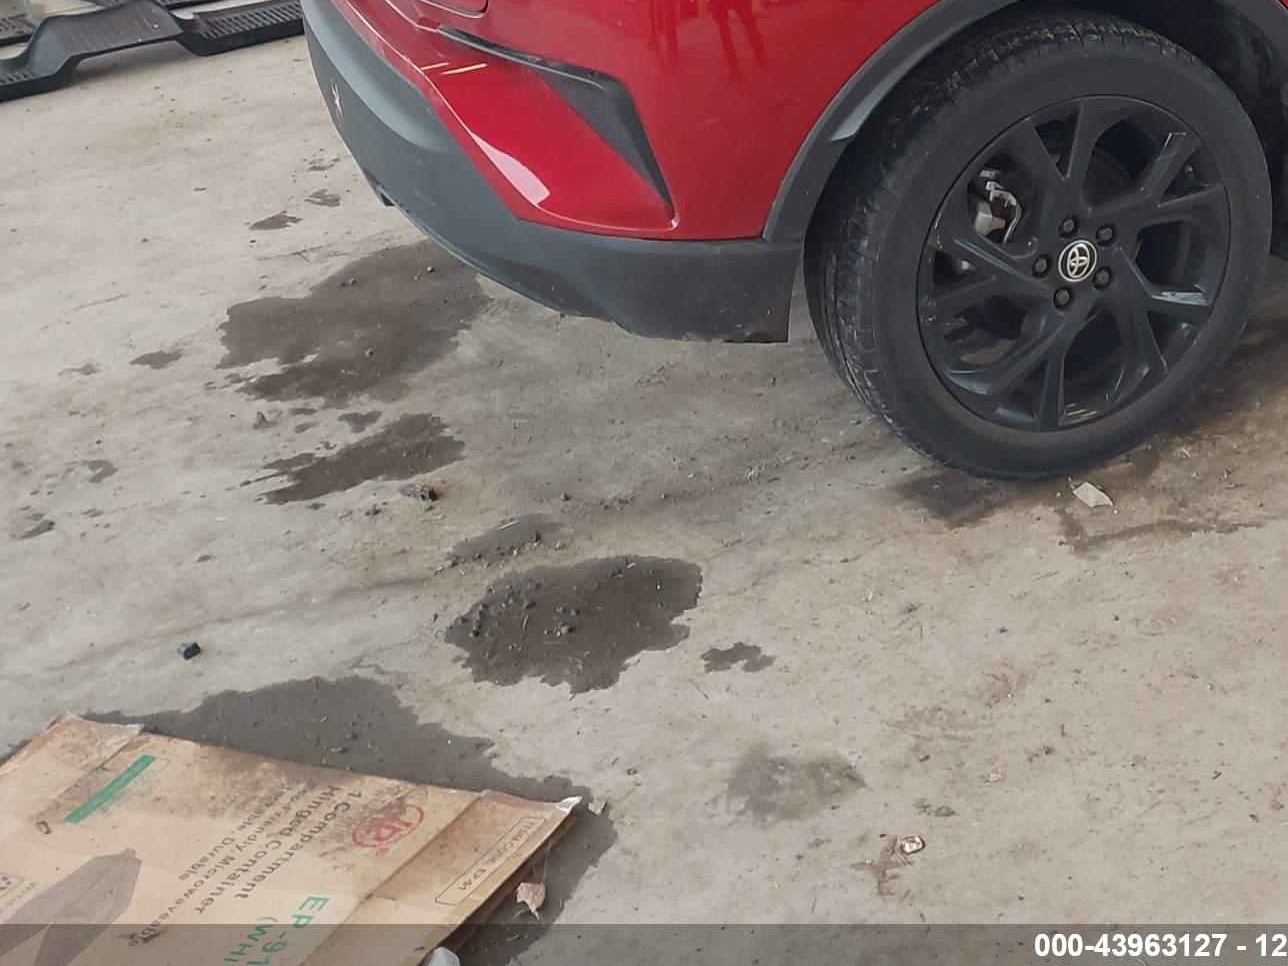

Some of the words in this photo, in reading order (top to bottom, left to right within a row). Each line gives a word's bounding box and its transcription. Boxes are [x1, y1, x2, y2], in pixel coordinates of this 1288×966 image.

[278, 785, 341, 837] Hinged
[347, 790, 362, 800] 1
[179, 837, 236, 881] Durable
[195, 839, 283, 915] Container
[234, 802, 351, 899] Compartment
[128, 854, 235, 947] Microwaveable
